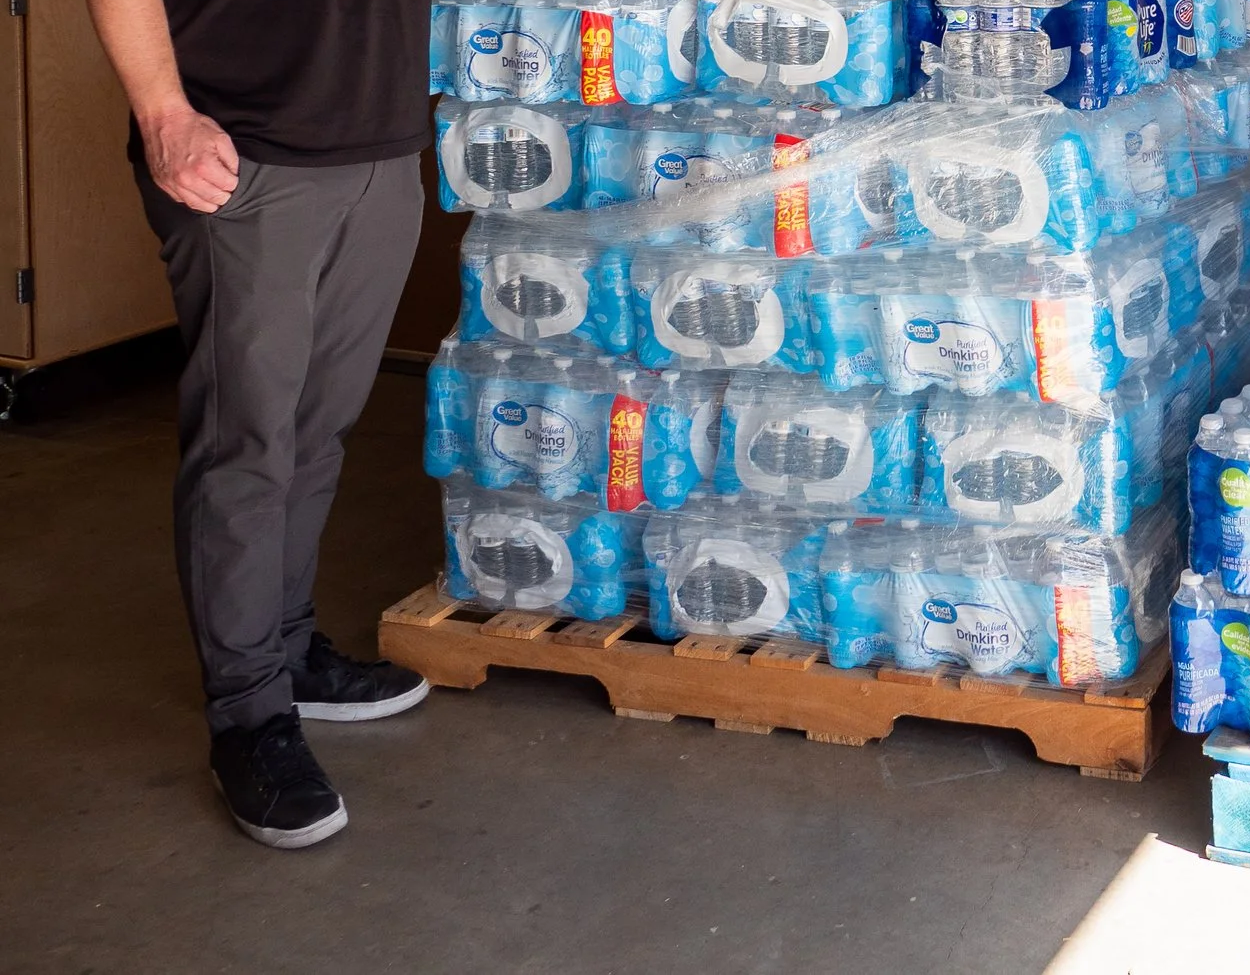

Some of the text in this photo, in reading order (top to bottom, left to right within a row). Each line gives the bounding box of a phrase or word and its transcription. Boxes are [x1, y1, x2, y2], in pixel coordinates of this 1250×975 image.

[1140, 3, 1157, 20] ure
[473, 34, 498, 44] Great
[583, 28, 612, 47] 40
[583, 67, 600, 103] PACK
[597, 65, 616, 102] VALUE
[658, 158, 683, 169] Great
[665, 167, 683, 175] Value
[776, 190, 791, 231] PACK
[791, 187, 806, 231] VALUE
[906, 323, 934, 333] Great
[914, 332, 935, 340] Value
[938, 346, 989, 362] Drinking
[953, 359, 990, 372] Water
[496, 405, 522, 416] Great
[503, 414, 522, 422] Value
[612, 410, 643, 429] 40
[611, 449, 625, 486] PACK
[625, 446, 639, 488] VALUE
[1221, 476, 1250, 489] Quality
[1223, 489, 1246, 500] Clear
[1220, 514, 1250, 526] PURIFIED
[926, 602, 951, 615] Great
[975, 622, 1008, 633] Purified
[956, 628, 1009, 646] Drinking
[1223, 630, 1250, 642] Calidad
[970, 643, 1011, 656] Water
[1178, 661, 1195, 671] AGUA
[1179, 668, 1220, 681] PURIFICADA
